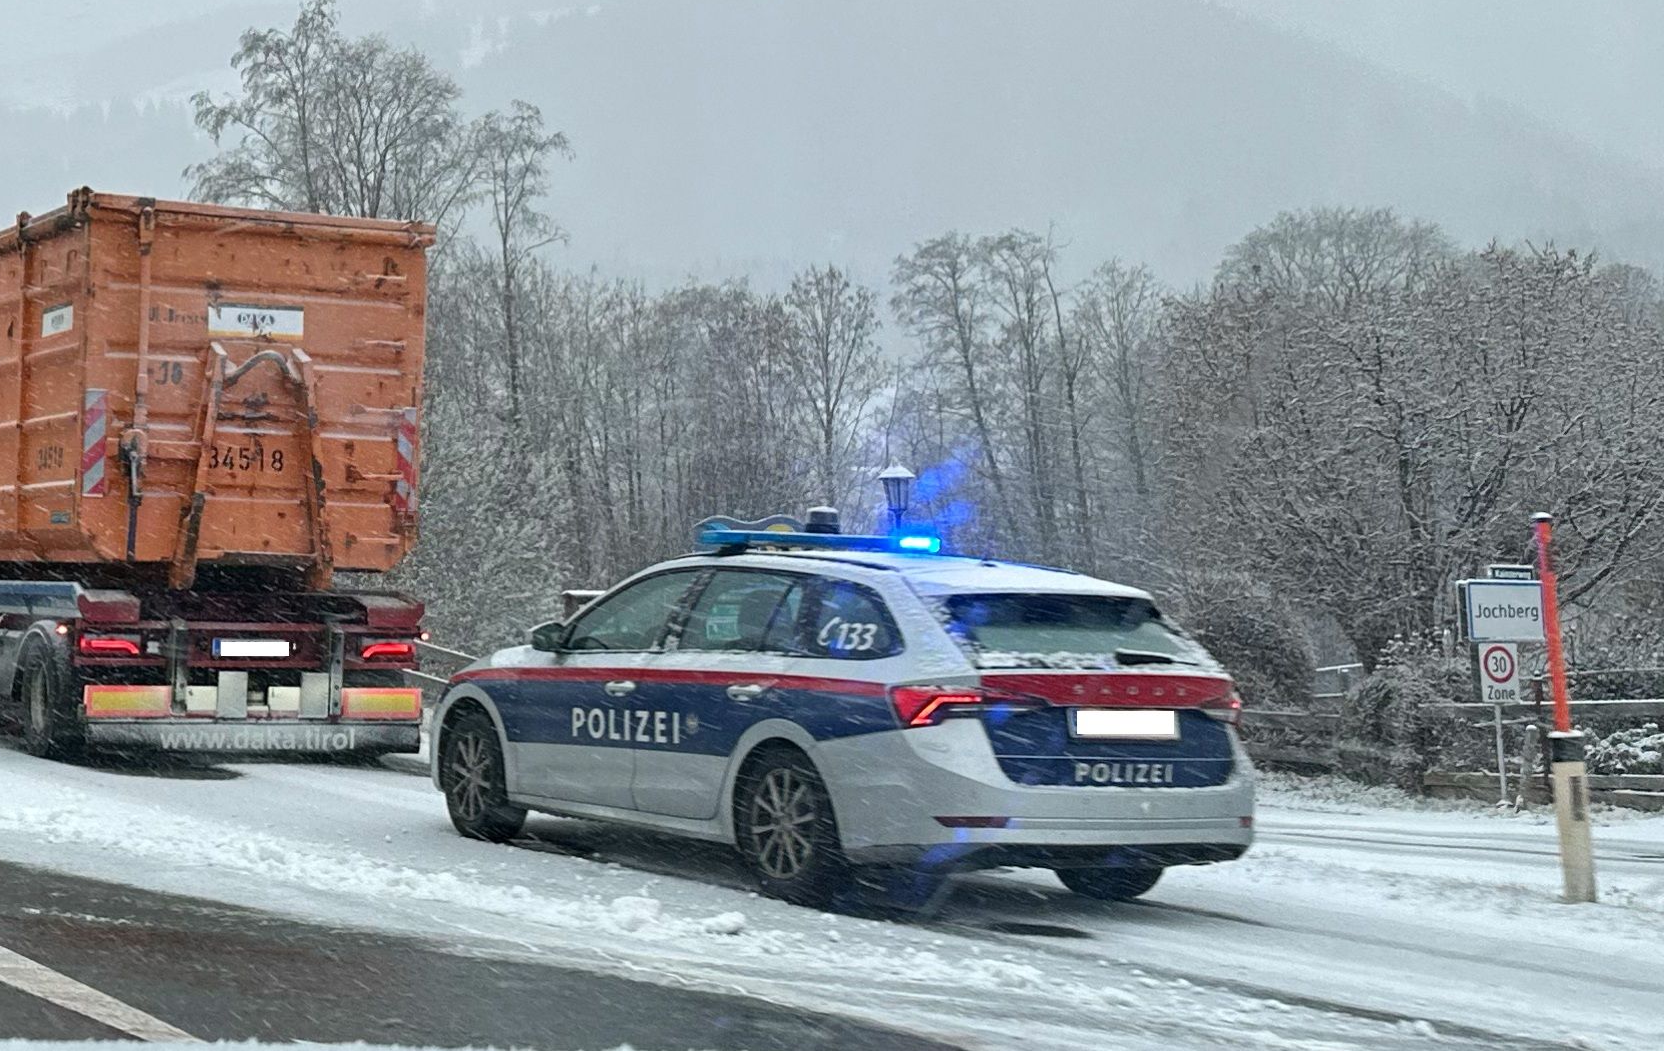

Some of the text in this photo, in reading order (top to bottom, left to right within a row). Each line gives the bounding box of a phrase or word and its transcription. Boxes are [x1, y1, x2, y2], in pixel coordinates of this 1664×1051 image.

[209, 446, 284, 472] 34518
[1475, 603, 1539, 622] Jochberg
[837, 623, 878, 651] 133
[1491, 656, 1507, 674] 30
[1487, 685, 1516, 701] Zone
[572, 707, 680, 744] POLIZEI
[160, 727, 355, 751] www.daka.tirol
[1074, 762, 1174, 784] POLIZEI
